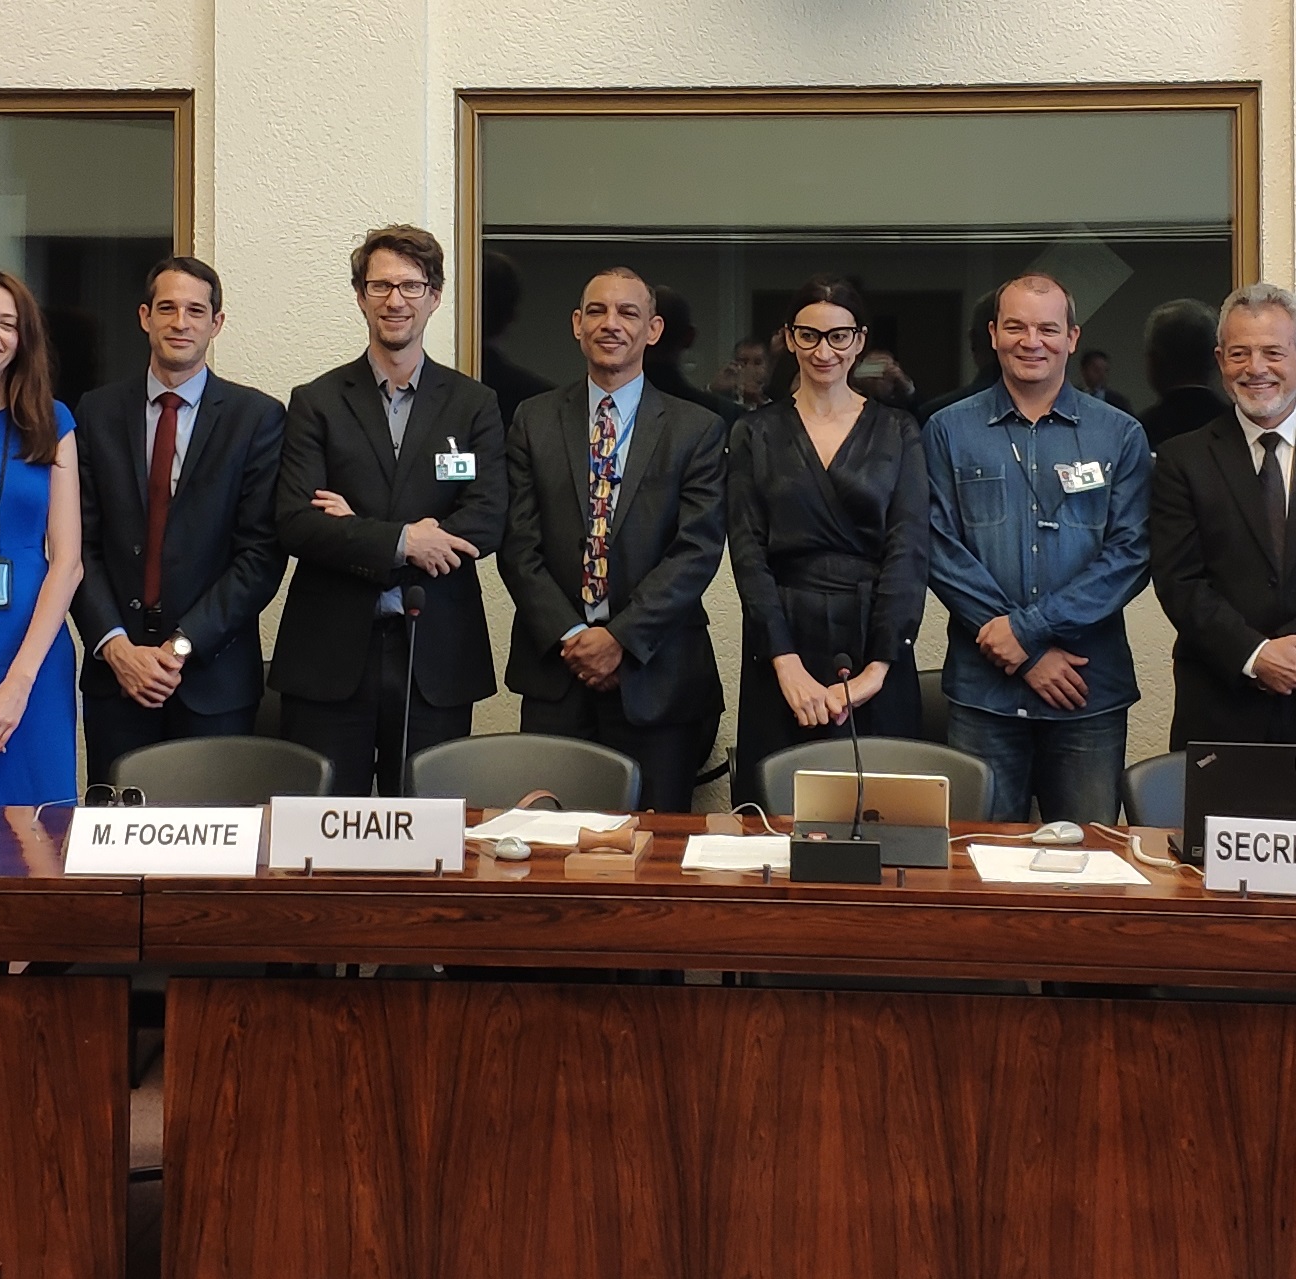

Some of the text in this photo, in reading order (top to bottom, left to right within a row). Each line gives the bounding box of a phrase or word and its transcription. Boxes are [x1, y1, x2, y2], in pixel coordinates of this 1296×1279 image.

[92, 824, 239, 846] M. FOGANTE
[320, 810, 414, 840] CHAIR
